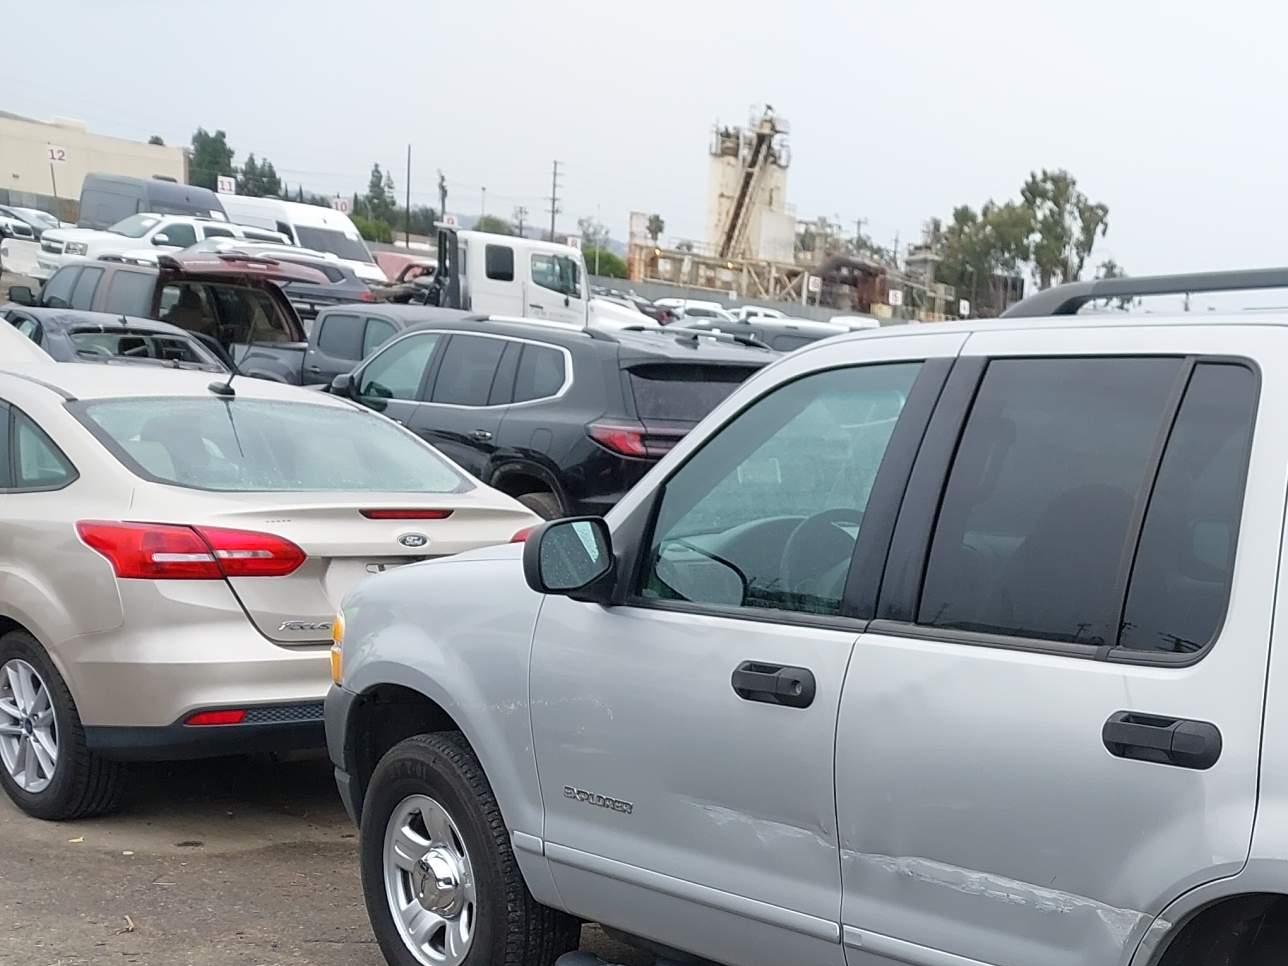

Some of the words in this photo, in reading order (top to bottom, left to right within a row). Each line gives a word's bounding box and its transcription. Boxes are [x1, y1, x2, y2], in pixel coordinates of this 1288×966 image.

[48, 148, 66, 162] 12
[219, 179, 235, 192] 11
[333, 200, 348, 213] 10
